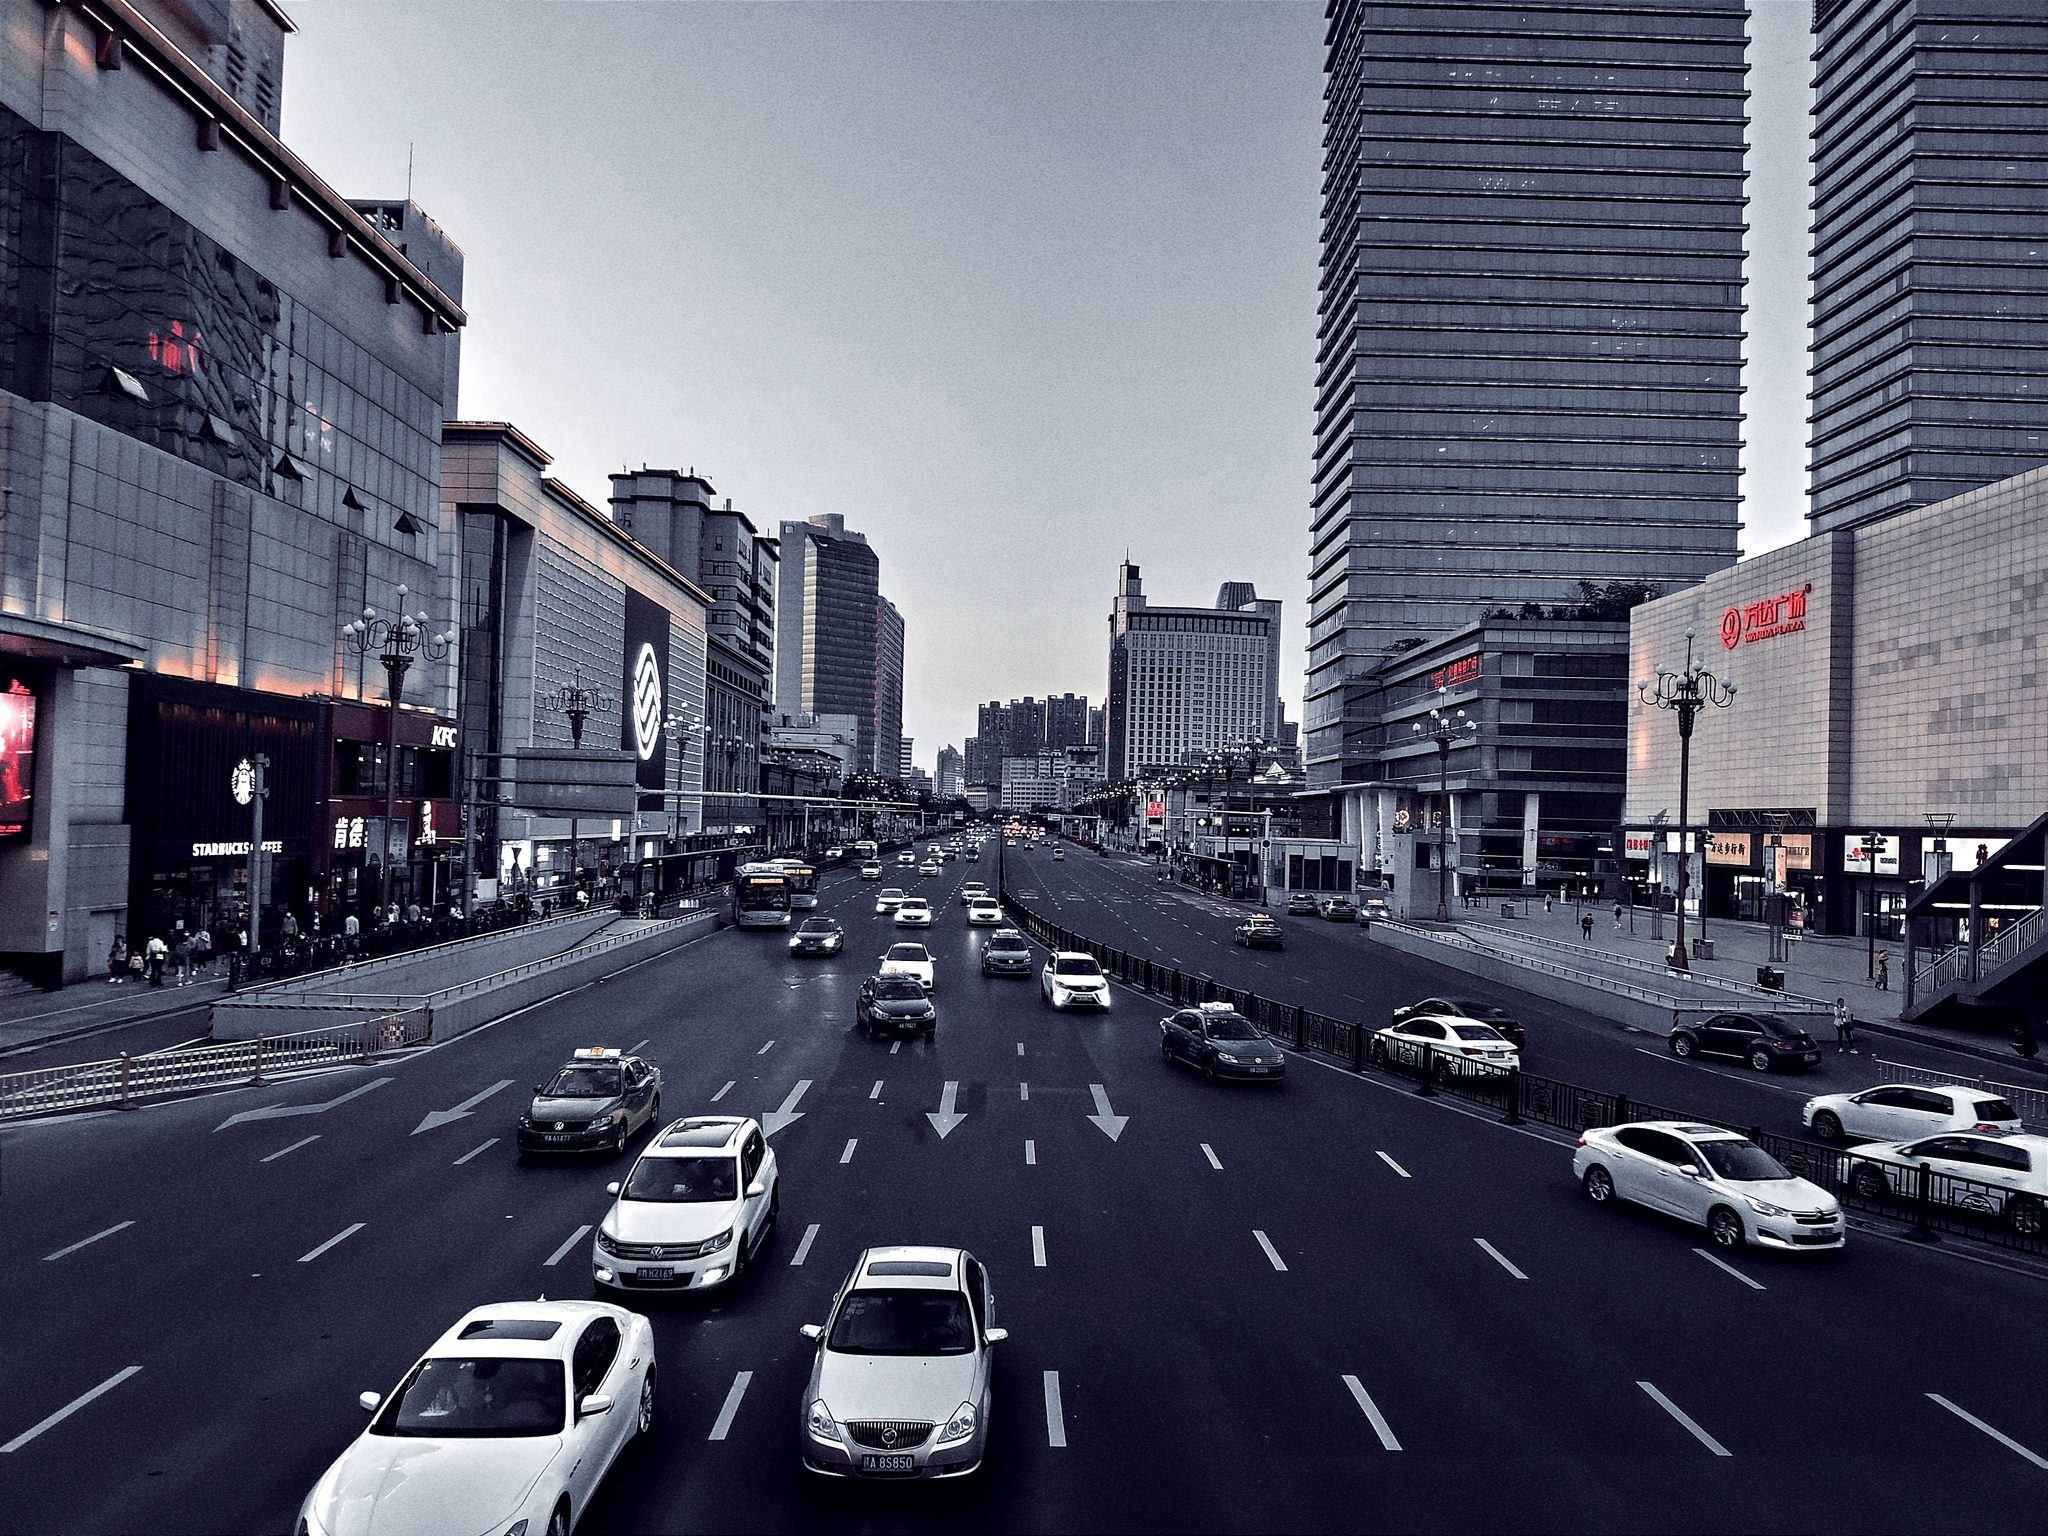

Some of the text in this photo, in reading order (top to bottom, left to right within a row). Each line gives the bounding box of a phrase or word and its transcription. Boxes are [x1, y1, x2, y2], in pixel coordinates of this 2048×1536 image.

[1743, 589, 1806, 631] 万达广场
[1743, 620, 1805, 643] WANDA PLAZA
[431, 725, 457, 748] KFC
[334, 816, 369, 849] 肯德
[192, 841, 283, 857] STARBUCKS FFEE
[1710, 842, 1746, 856] 万达步行街
